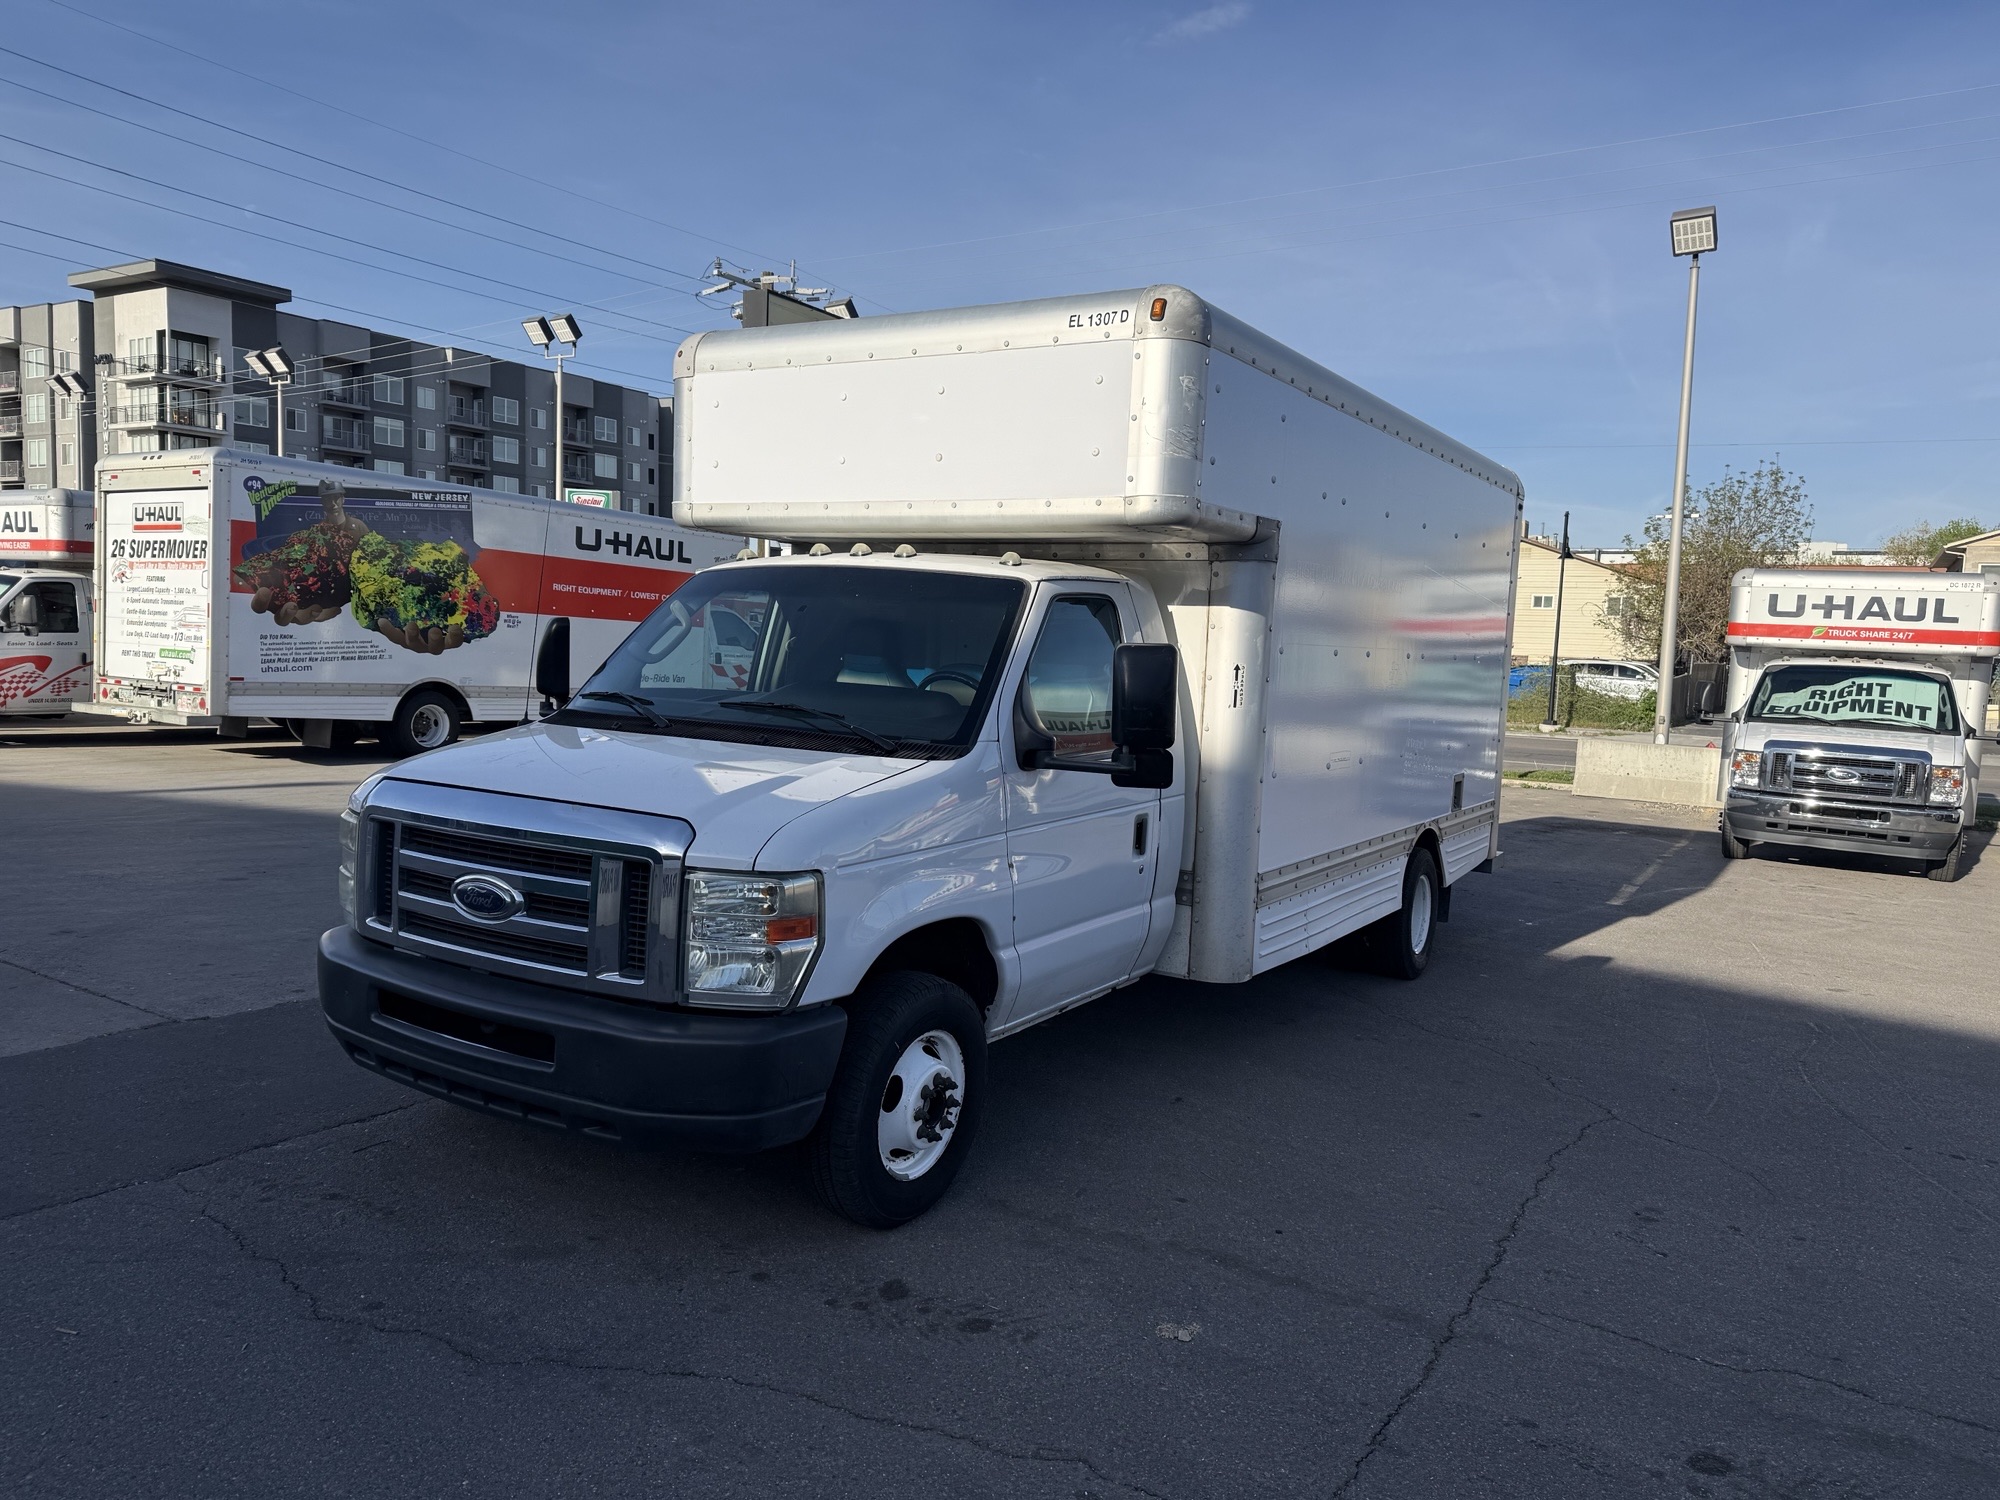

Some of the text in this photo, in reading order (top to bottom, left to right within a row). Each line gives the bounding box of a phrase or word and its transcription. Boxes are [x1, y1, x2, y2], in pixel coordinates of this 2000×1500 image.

[1068, 309, 1129, 328] EL 1307 D
[247, 480, 261, 490] #94
[248, 483, 279, 503] Venture
[261, 486, 297, 521] America
[411, 492, 469, 502] NEW JERSEY
[576, 496, 603, 506] Sinclair
[134, 506, 182, 521] U-HAUL
[575, 526, 692, 565] U-HAUL
[552, 583, 577, 593] RIGHT
[578, 585, 623, 597] EQUIPMENT
[630, 591, 660, 600] LOWEST
[1767, 593, 1960, 624] U-HAUL
[174, 632, 184, 642] 1/3
[1828, 629, 1915, 640] TRUCK SHARE 24/7
[261, 664, 313, 673] uhaul.com
[672, 674, 686, 683] Van
[1808, 682, 1893, 701] RIGHT
[1766, 699, 1933, 722] EQUIPMENT
[463, 886, 494, 908] Ford
